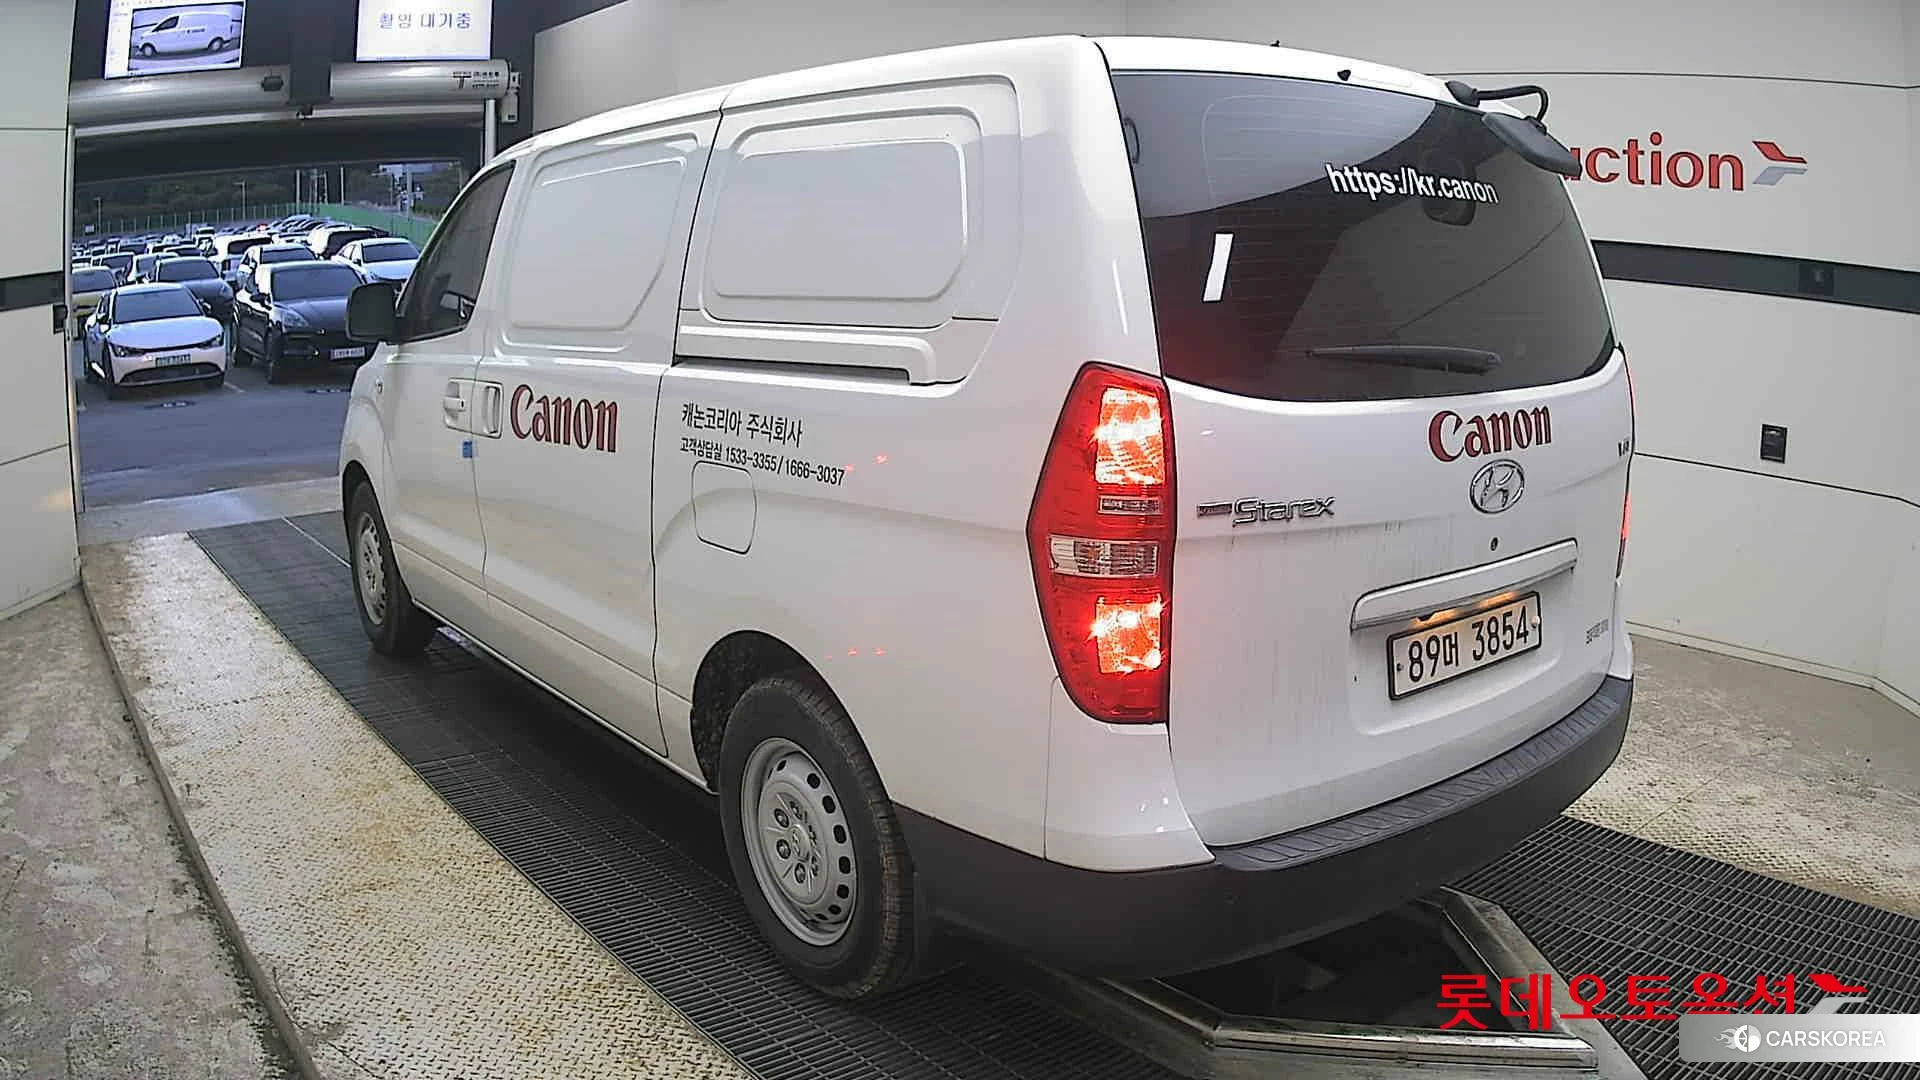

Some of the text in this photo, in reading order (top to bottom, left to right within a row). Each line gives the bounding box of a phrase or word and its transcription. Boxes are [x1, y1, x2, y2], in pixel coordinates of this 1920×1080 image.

[420, 11, 472, 30] 대기중
[1325, 162, 1499, 205] https://kr.canon
[1563, 132, 1744, 191] ction
[510, 383, 618, 453] Canon
[681, 401, 804, 449] 캐논코리아 주식회사
[1428, 405, 1552, 463] Canon
[679, 436, 723, 461] 고객상담실
[1231, 495, 1337, 528] Starex
[1471, 605, 1530, 662] 3854
